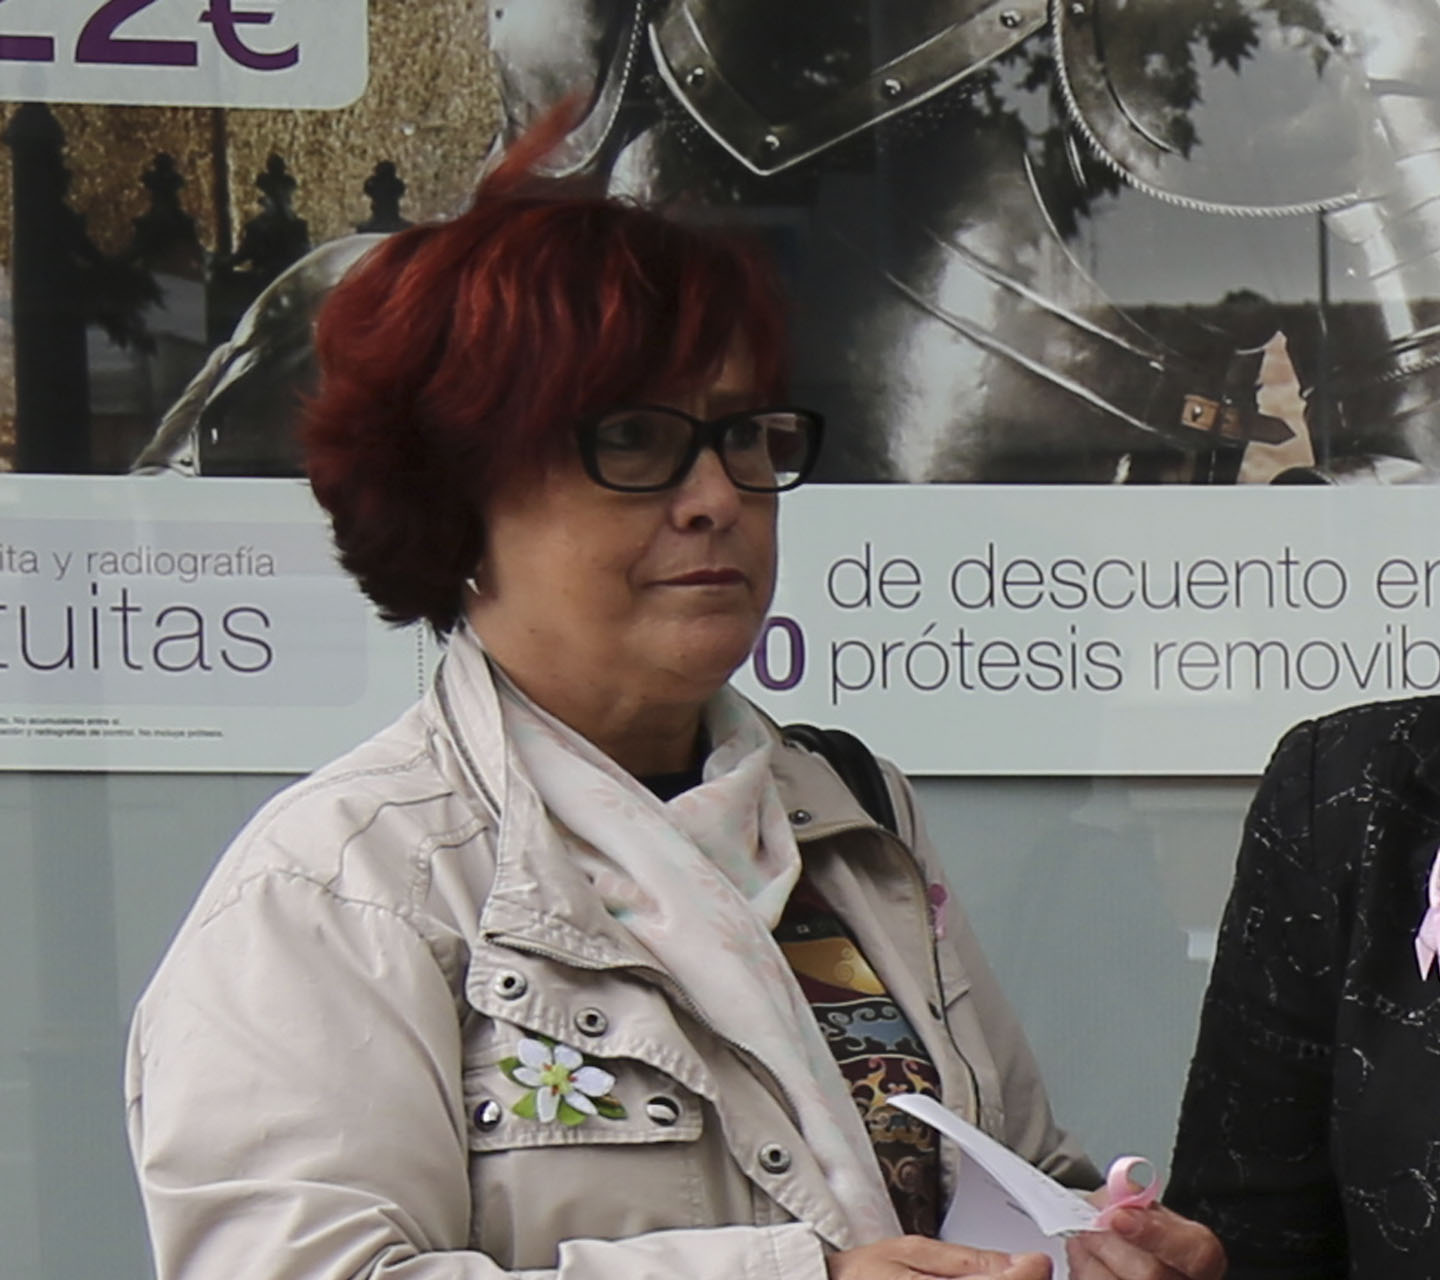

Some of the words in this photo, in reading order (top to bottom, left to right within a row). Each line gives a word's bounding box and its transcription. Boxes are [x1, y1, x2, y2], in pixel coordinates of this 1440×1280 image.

[52, 551, 73, 581] y
[86, 546, 275, 583] radiografía
[827, 542, 922, 610] de
[950, 542, 1348, 610] descuento
[0, 582, 273, 673] uitas
[831, 622, 1124, 707] prótesis
